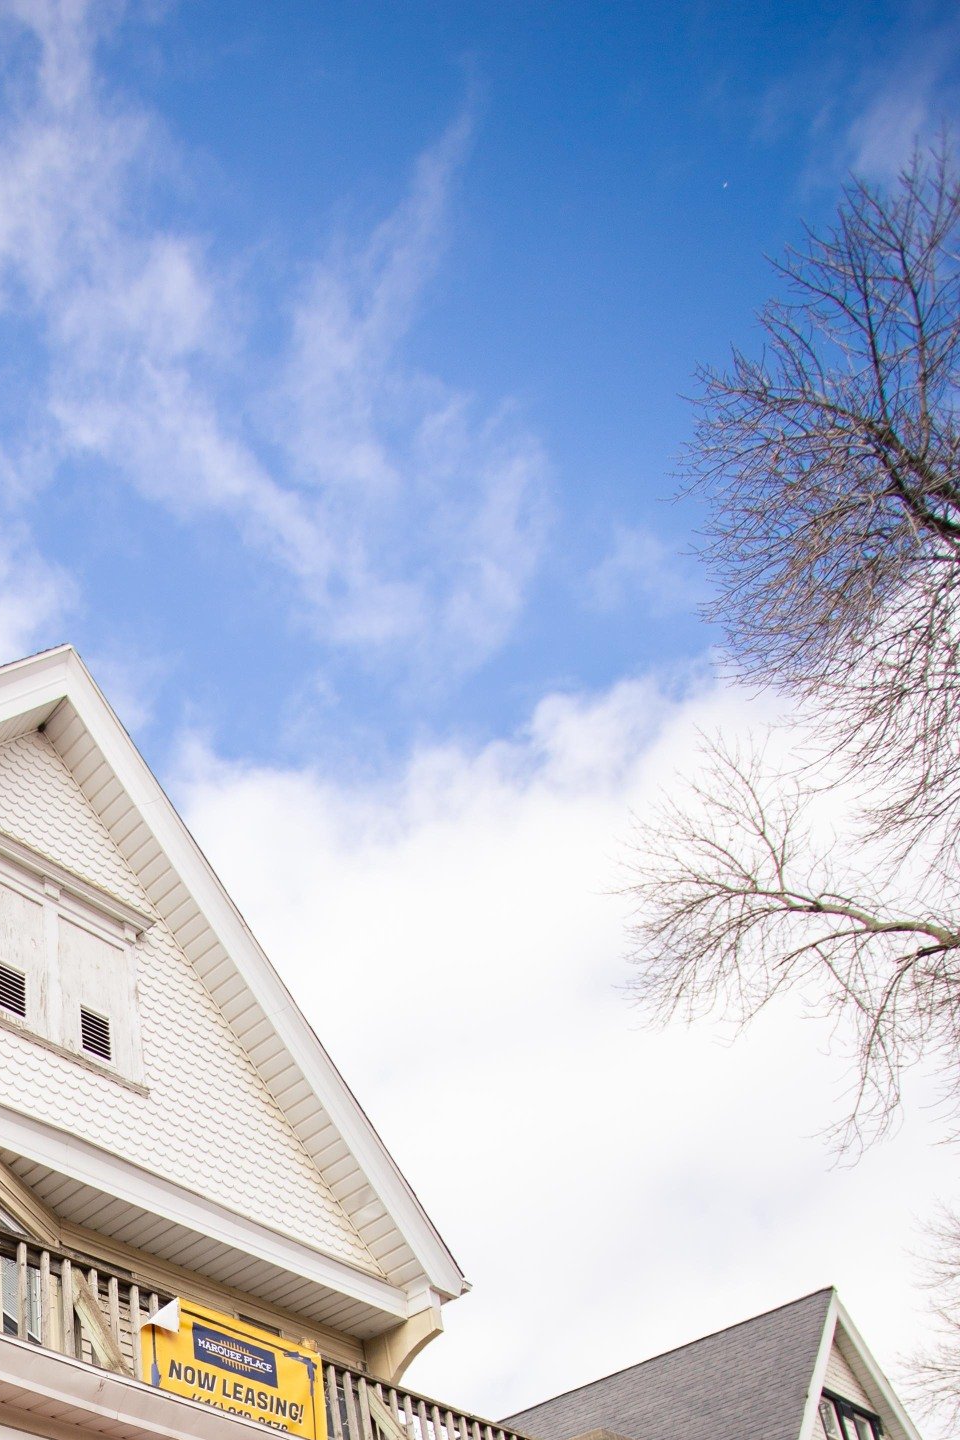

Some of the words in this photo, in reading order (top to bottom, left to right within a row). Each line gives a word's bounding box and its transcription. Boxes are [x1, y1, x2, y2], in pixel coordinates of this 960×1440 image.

[197, 1338, 242, 1361] MARQUEE
[243, 1356, 273, 1372] PLACE
[168, 1359, 216, 1391] NOW
[222, 1379, 304, 1424] LEASING!
